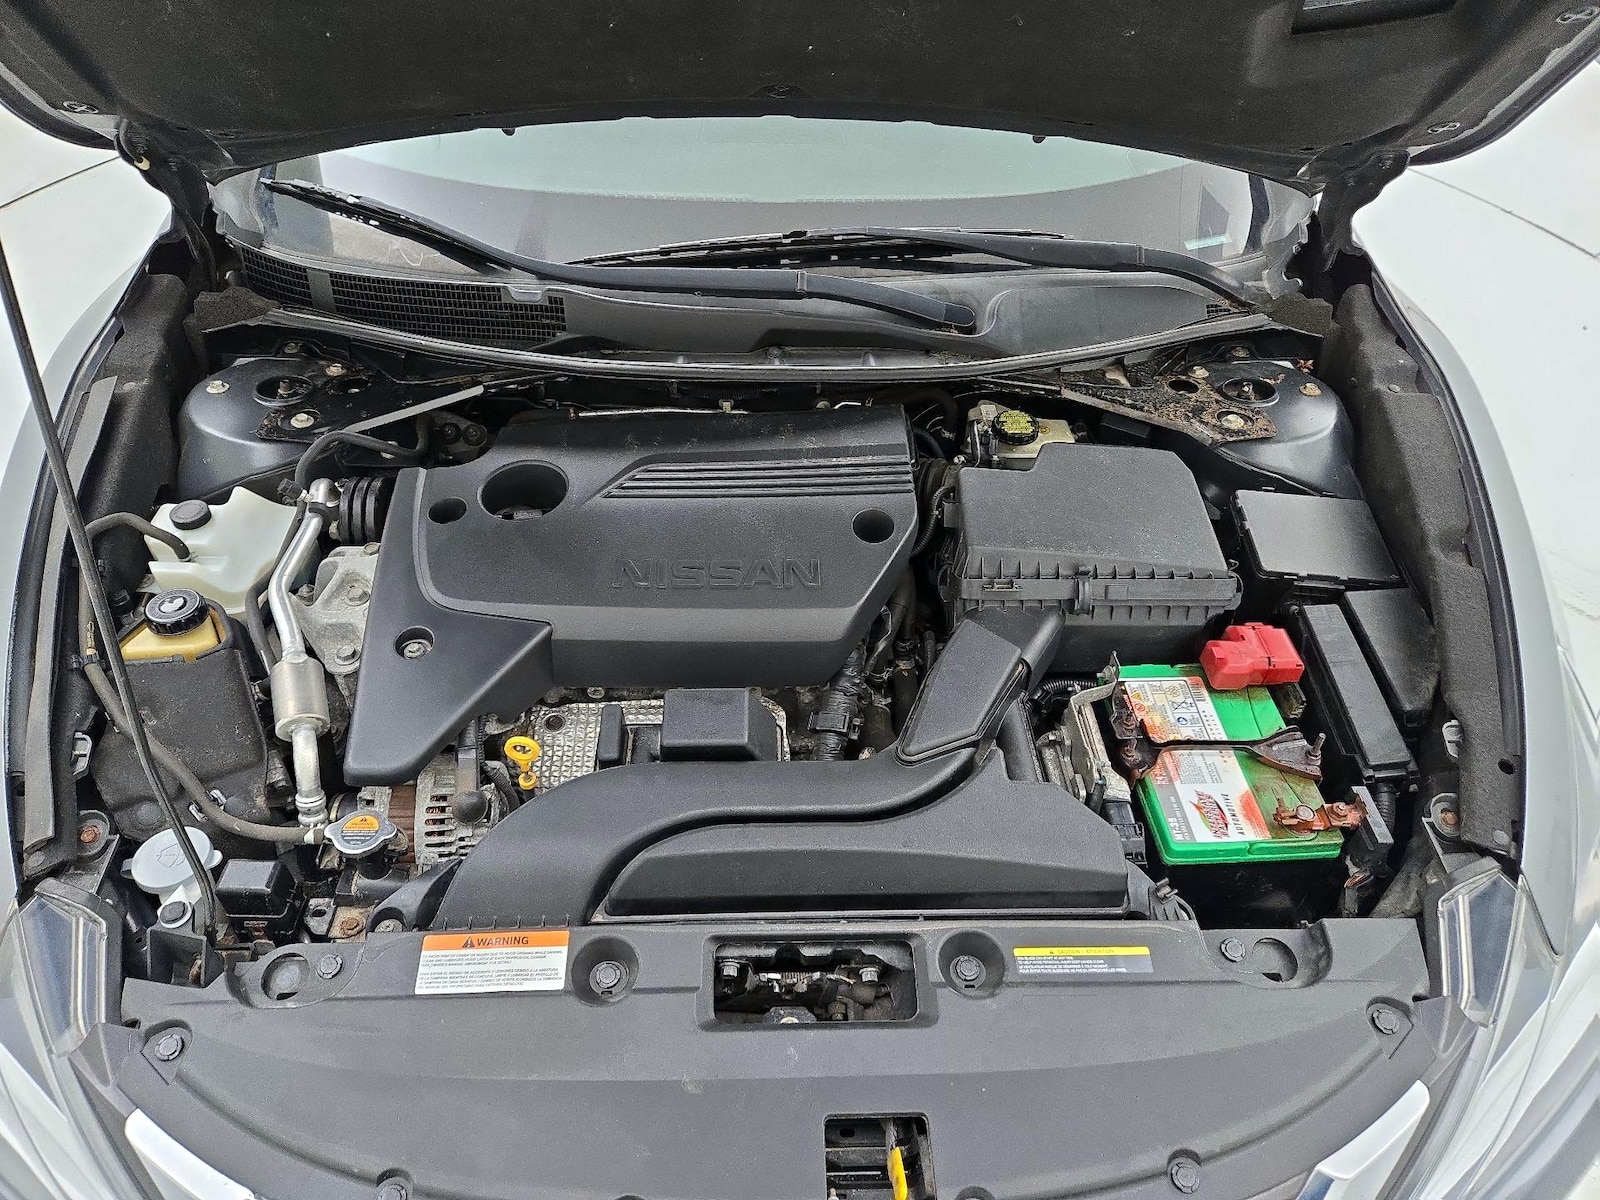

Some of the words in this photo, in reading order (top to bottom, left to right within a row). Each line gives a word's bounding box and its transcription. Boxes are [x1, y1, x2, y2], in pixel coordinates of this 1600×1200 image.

[612, 558, 821, 589] NISSAN
[1221, 793, 1245, 835] AUTOMOTIVE
[477, 936, 529, 946] WARNING
